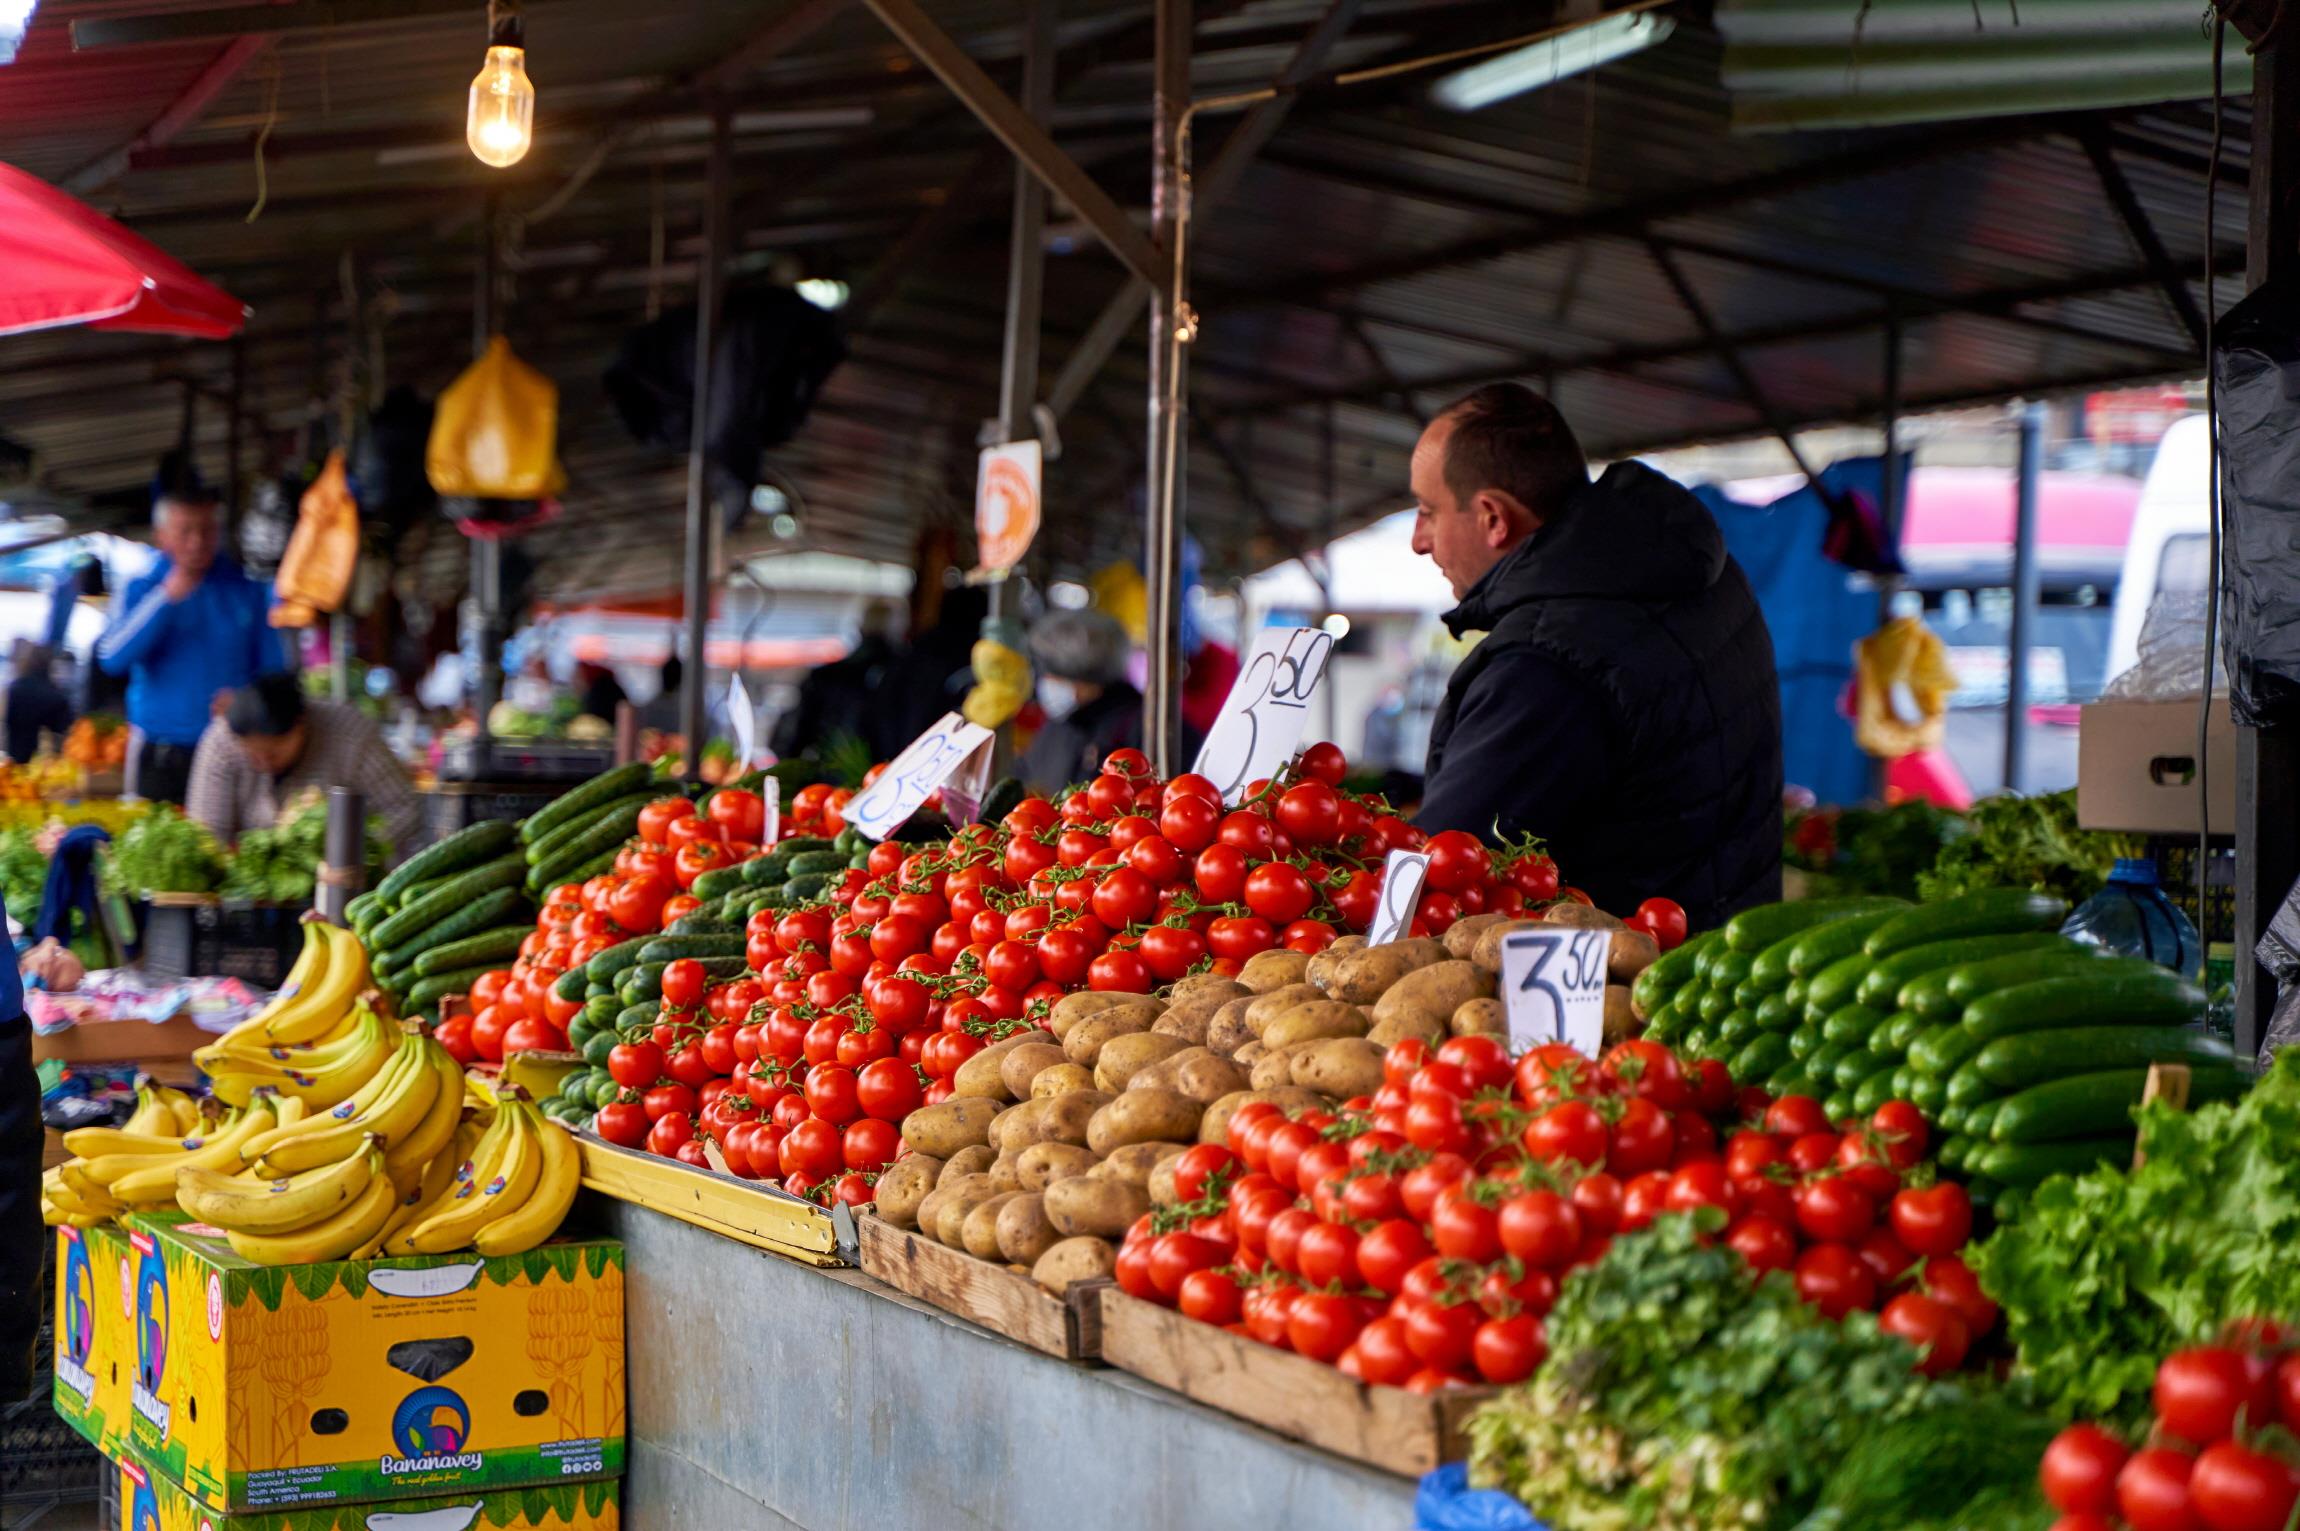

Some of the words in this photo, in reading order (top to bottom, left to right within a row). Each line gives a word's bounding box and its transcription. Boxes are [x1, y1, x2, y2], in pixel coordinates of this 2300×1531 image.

[381, 1453, 482, 1475] Bananavey
[247, 1471, 275, 1480] Packed
[288, 1466, 324, 1476] FRUTADELI
[247, 1479, 285, 1490] Guayaquil
[291, 1475, 323, 1485] Ecuador
[247, 1488, 268, 1498] South
[269, 1485, 300, 1495] America
[247, 1496, 273, 1505] Phone:
